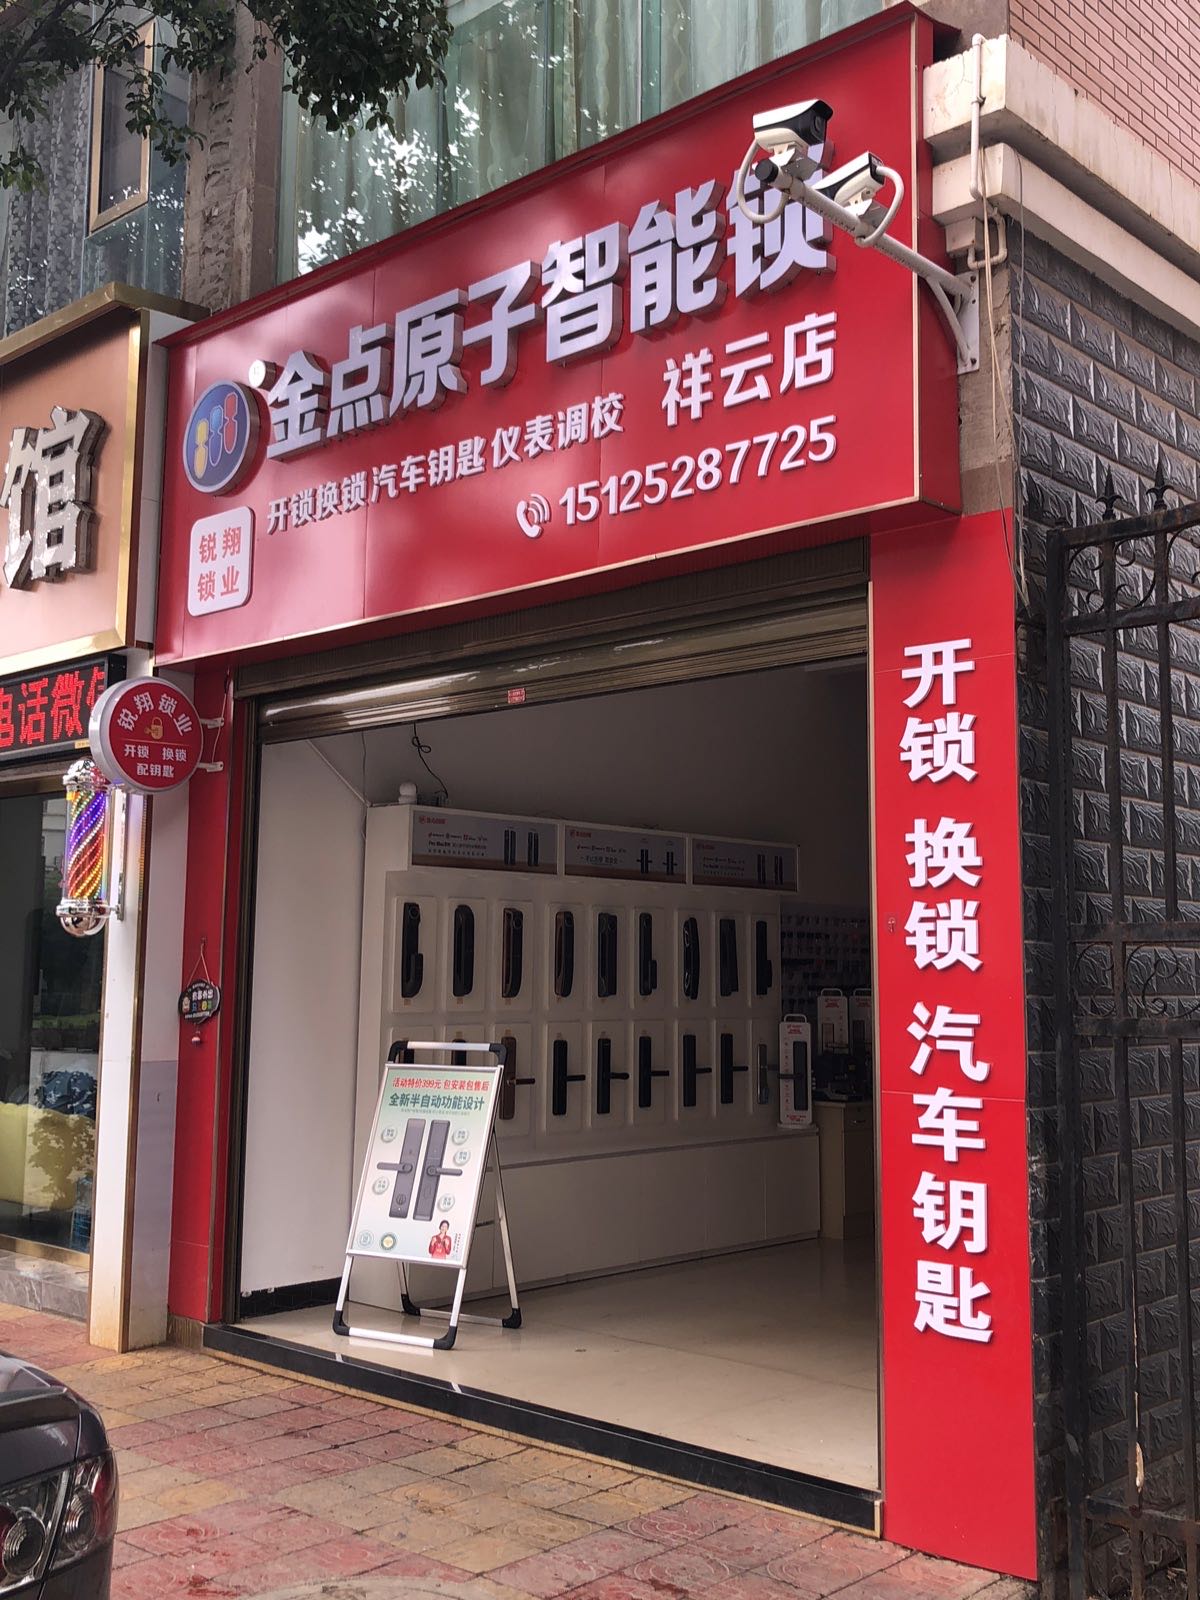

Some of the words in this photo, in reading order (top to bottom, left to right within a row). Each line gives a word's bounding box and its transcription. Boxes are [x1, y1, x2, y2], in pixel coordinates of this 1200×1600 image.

[266, 142, 833, 459] 金点原子智能锁
[662, 311, 837, 427] 祥云店
[0, 405, 100, 588] 馆
[267, 471, 367, 534] 开锁换锁
[371, 435, 487, 503] 汽车钥匙
[491, 392, 625, 469] 仪表调校
[558, 415, 837, 525] 15125287725
[197, 565, 240, 602] 锁业
[199, 526, 242, 564] 锐翔
[117, 691, 193, 737] 锐翔锁业
[124, 743, 150, 759] 开锁
[162, 746, 187, 762] 换锁
[899, 638, 978, 784] 开锁
[136, 763, 175, 778] 配钥匙
[904, 816, 983, 972] 换锁
[388, 1093, 485, 1111] 全新半自动功能设计
[906, 1000, 995, 1343] 汽车钥匙
